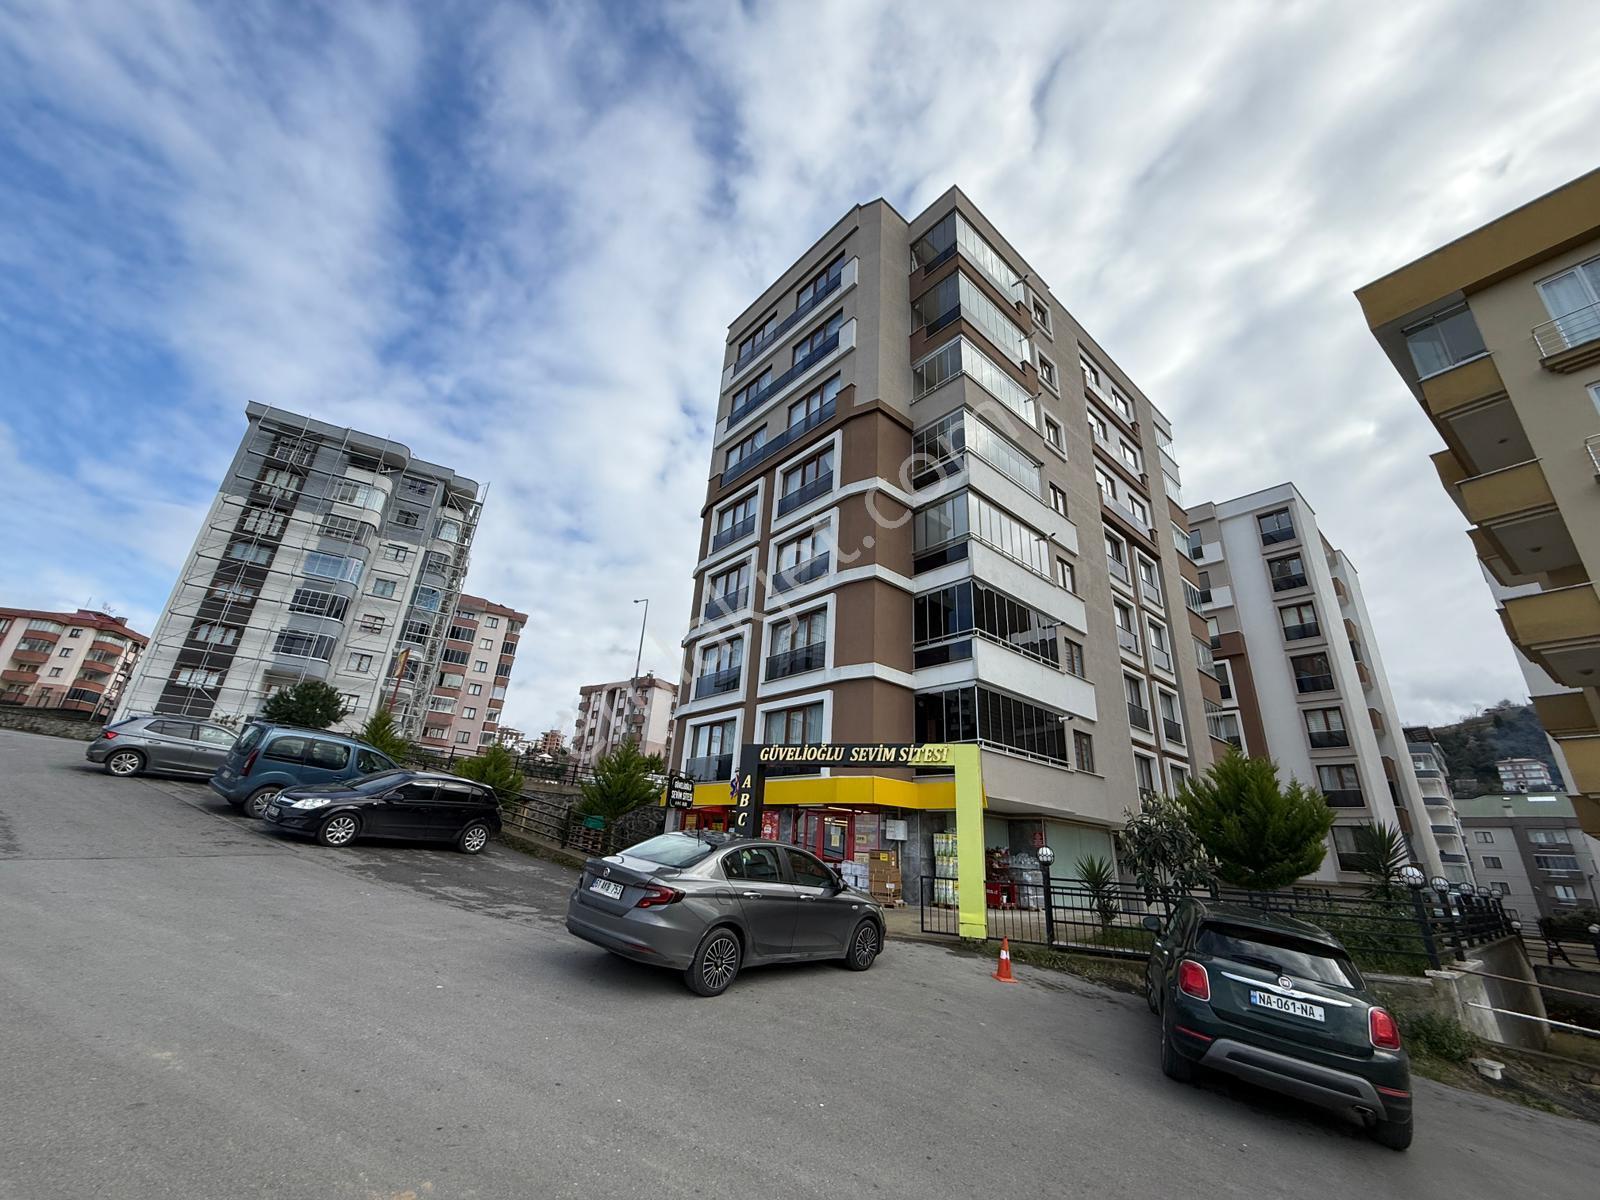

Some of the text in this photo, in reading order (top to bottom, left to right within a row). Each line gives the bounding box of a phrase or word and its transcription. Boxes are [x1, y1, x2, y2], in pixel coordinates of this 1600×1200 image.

[759, 743, 949, 763] GÜVELİOĞLU SEVİM SİTESİ
[738, 774, 751, 827] A B C
[611, 884, 622, 895] 753
[1258, 993, 1315, 1017] NA-061-NA
